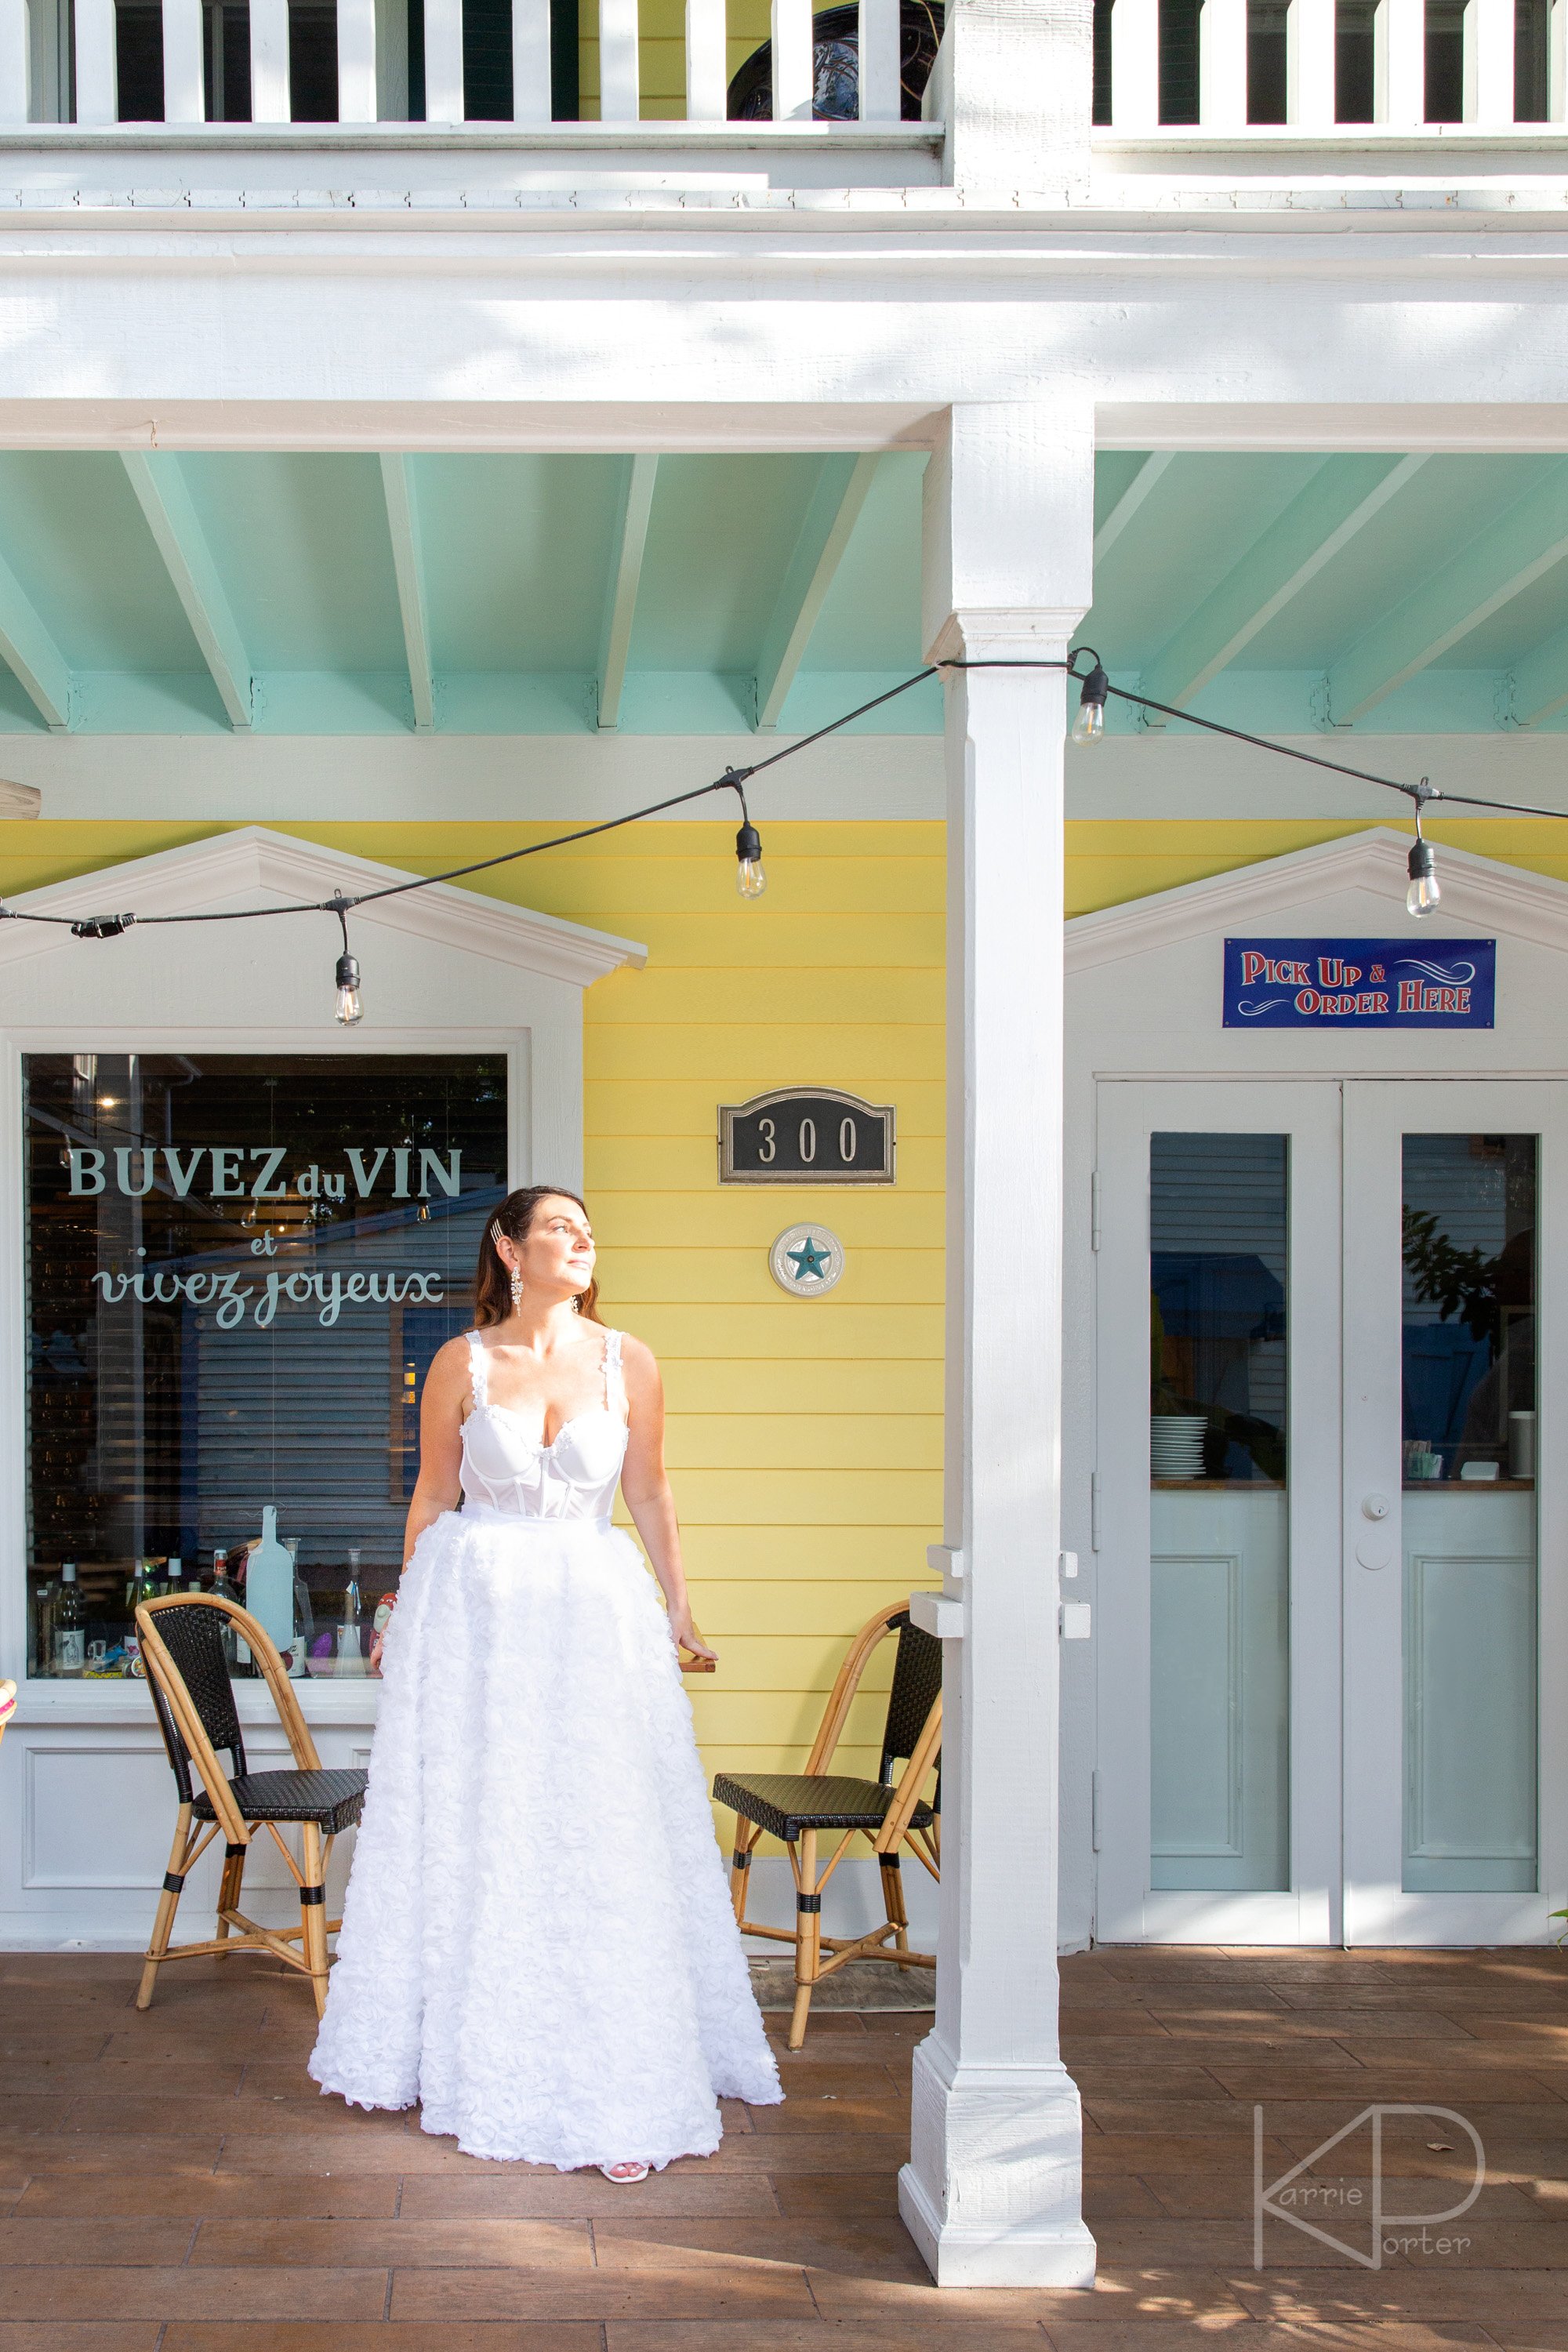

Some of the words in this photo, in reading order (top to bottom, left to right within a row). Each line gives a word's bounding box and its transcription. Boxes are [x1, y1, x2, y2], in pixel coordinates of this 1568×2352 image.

[1370, 964, 1386, 983] &
[758, 1117, 857, 1163] 300
[68, 1147, 287, 1196] BUVEZ
[297, 1164, 346, 1197] du
[343, 1147, 463, 1198] VIN
[250, 1229, 278, 1256] et
[91, 1247, 253, 1330] vivez
[253, 1266, 444, 1327] joyeux
